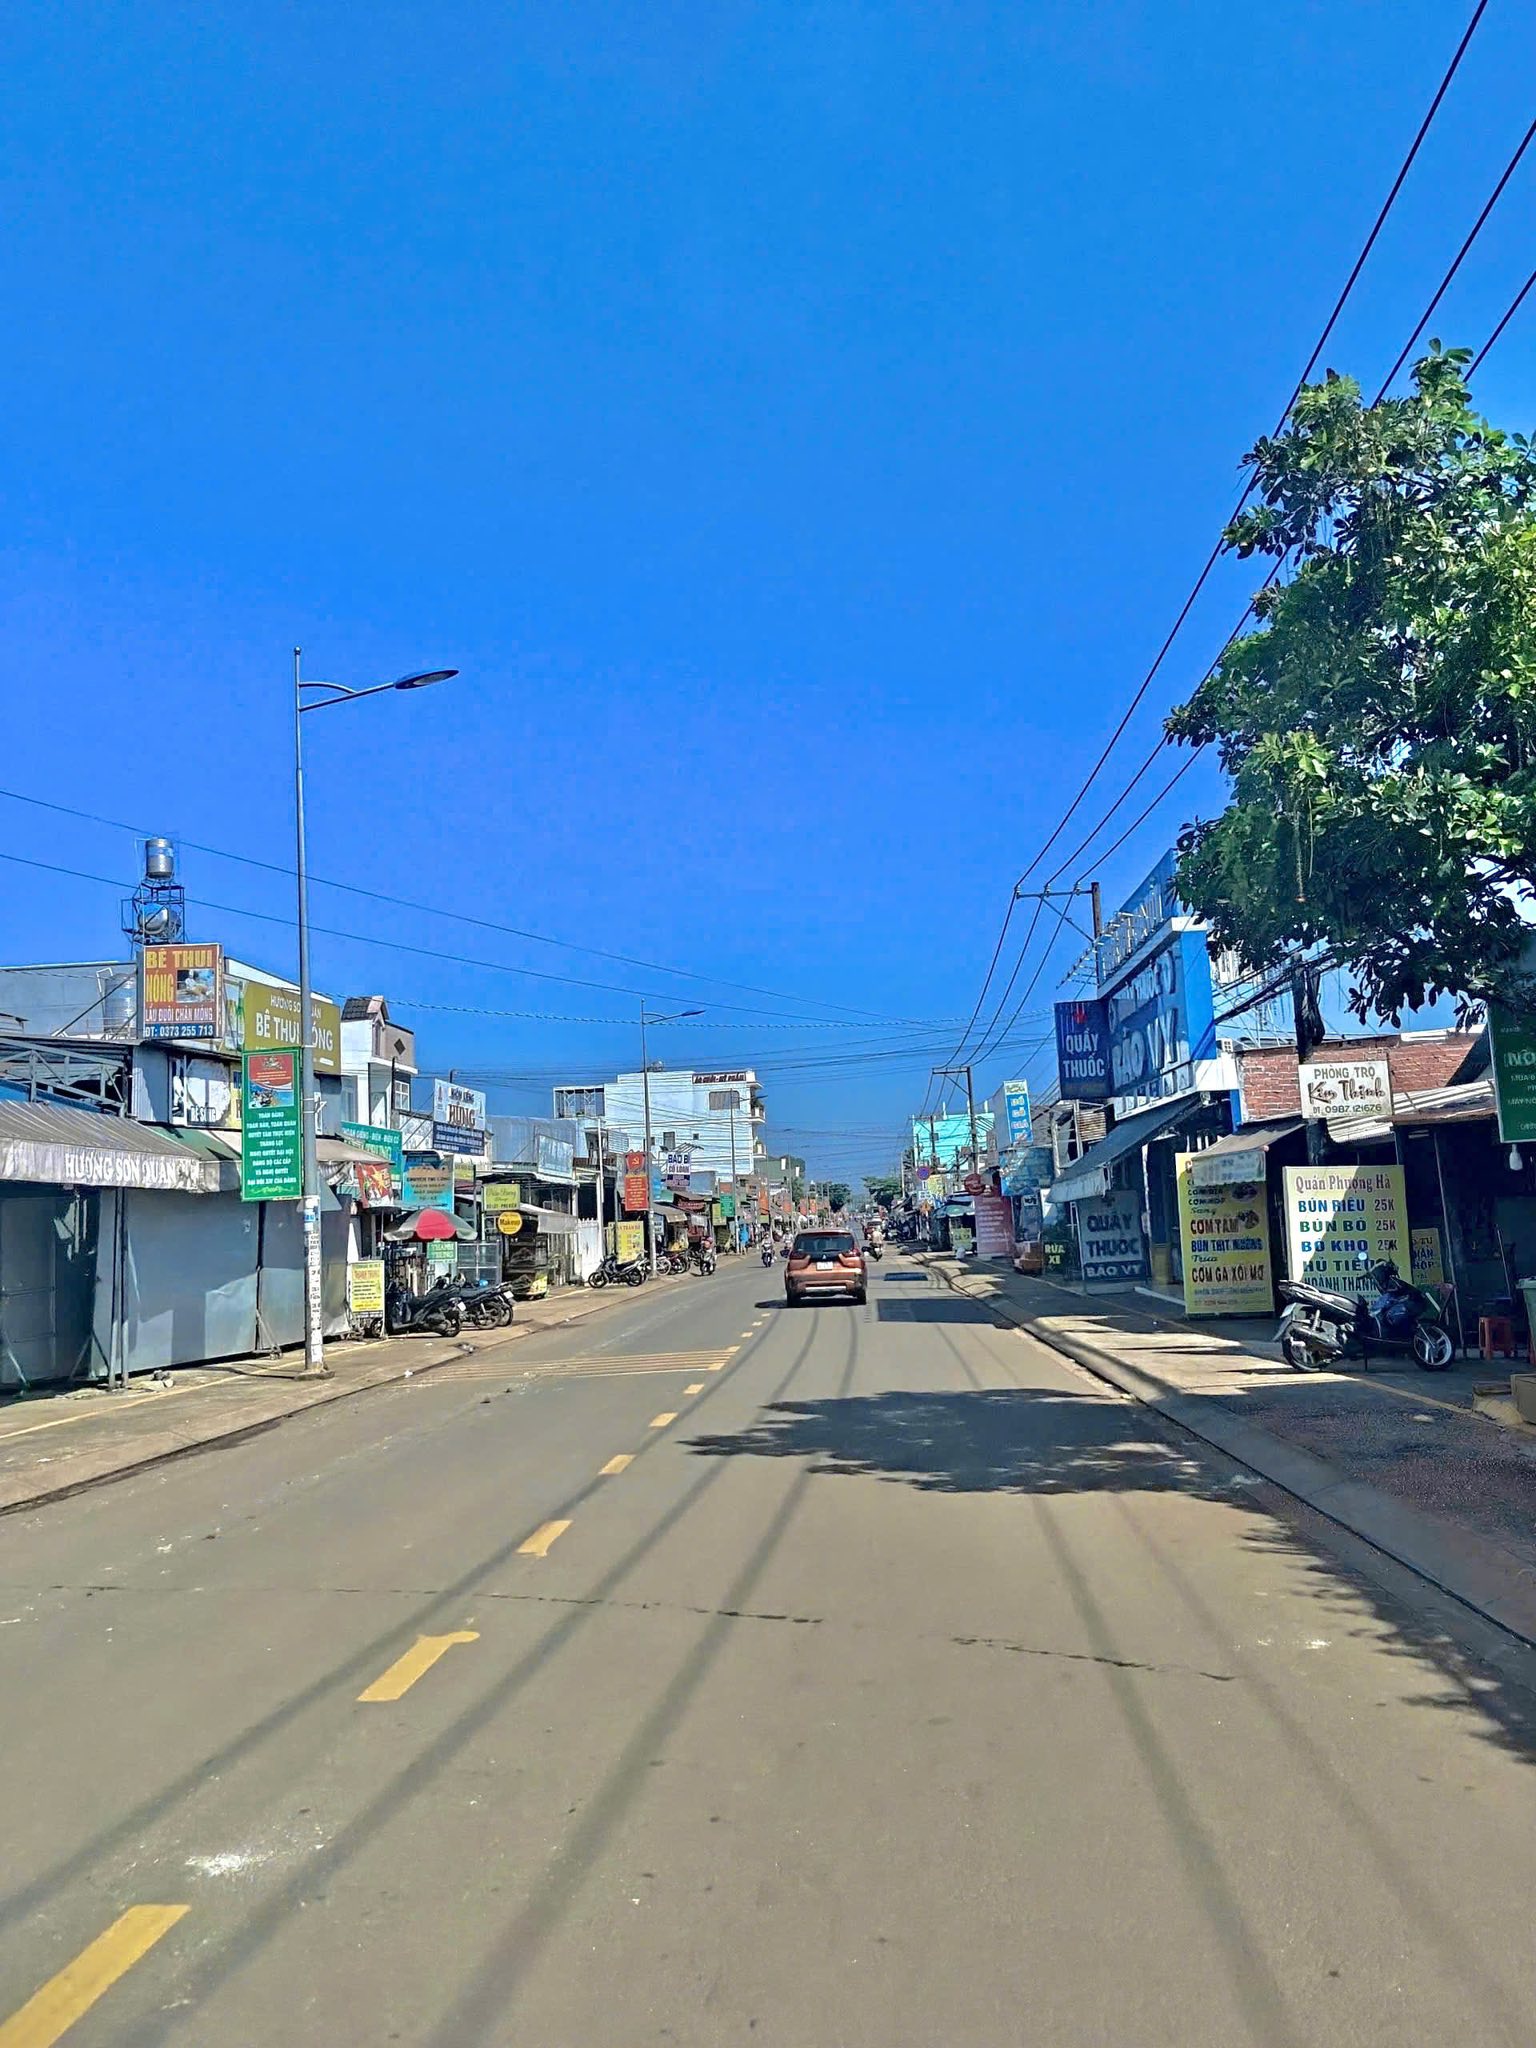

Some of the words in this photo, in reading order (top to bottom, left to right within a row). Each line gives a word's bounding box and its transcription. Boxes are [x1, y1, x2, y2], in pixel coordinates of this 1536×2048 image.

[146, 948, 167, 968] BÊ
[172, 950, 213, 968] THUI
[160, 1026, 179, 1037] 0373
[181, 1025, 197, 1037] 255
[199, 1025, 213, 1036] 713
[256, 1008, 271, 1038] BÊ
[274, 1017, 300, 1045] THUI
[311, 1021, 334, 1051] ÓNG
[1066, 1028, 1098, 1053] QUẦY
[1063, 1054, 1105, 1078] THUỐC
[1314, 1065, 1349, 1080] PHÒNG
[1354, 1066, 1375, 1080] TRỌ
[1307, 1081, 1337, 1105] Kim
[1338, 1077, 1386, 1101] Thịnh
[1296, 1175, 1326, 1193] Quán
[1328, 1175, 1372, 1193] Phượng
[1376, 1173, 1391, 1189] Hà
[1298, 1198, 1327, 1212] BÚN
[1332, 1197, 1365, 1212] RIÊU
[1374, 1199, 1395, 1211] 25K
[1299, 1218, 1337, 1232] BÚN
[1343, 1217, 1367, 1232] BÒ
[1376, 1220, 1396, 1231] 25K
[1301, 1238, 1325, 1252] BÒ
[1331, 1239, 1368, 1252] KHO
[1378, 1239, 1398, 1251] 25K
